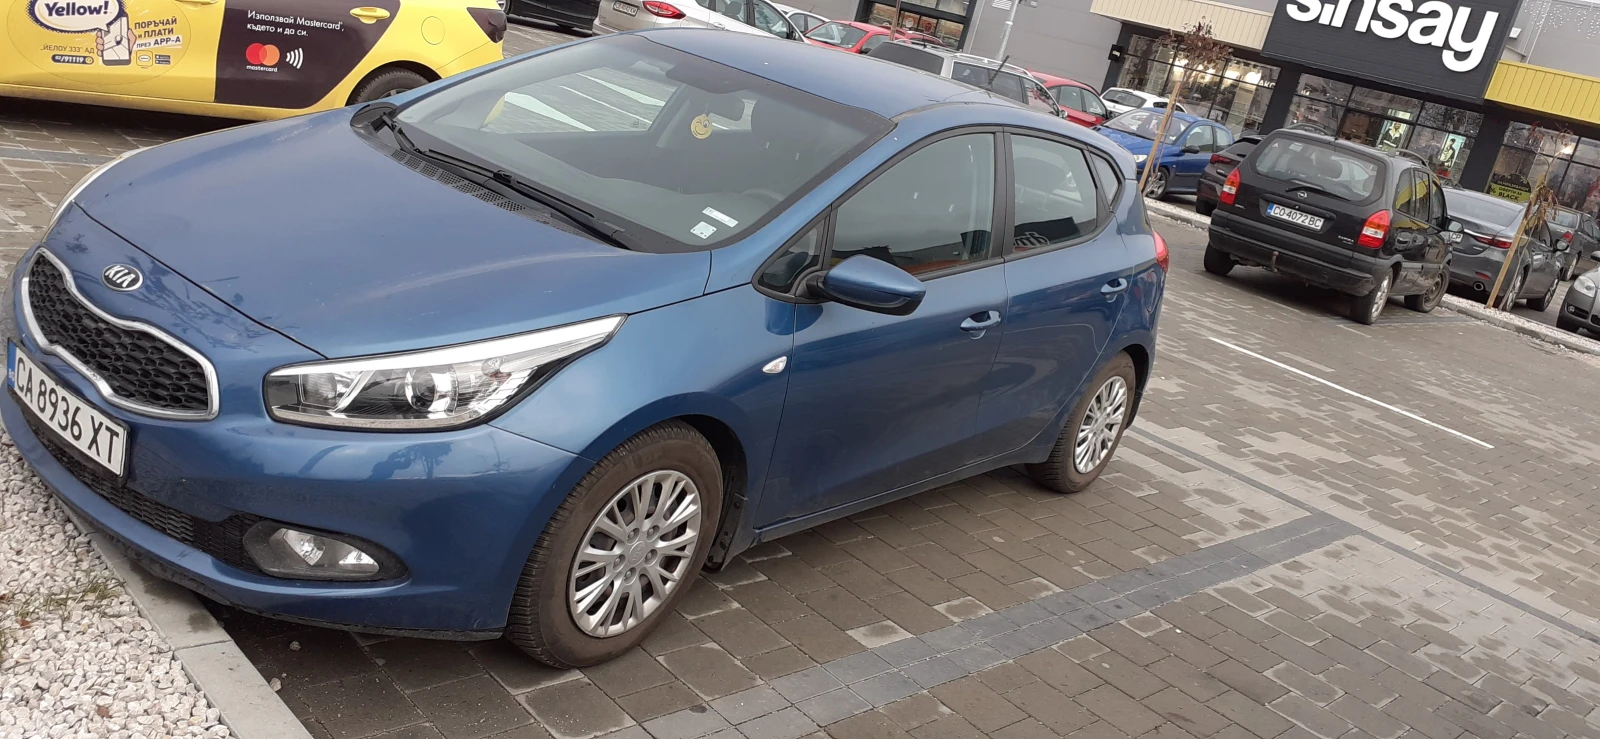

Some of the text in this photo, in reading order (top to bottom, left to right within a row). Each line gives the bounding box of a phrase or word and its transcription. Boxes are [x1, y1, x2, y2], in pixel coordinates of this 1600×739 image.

[44, 1, 109, 17] Yellow!
[247, 9, 295, 24] Използвай
[134, 16, 177, 29] ПОРЪЧАЙ
[247, 23, 275, 32] където
[143, 27, 174, 39] ПЛАТИ
[1498, 191, 1520, 202] BLACK
[1286, 211, 1308, 224] 4072
[1308, 217, 1322, 228] BC
[104, 264, 136, 288] KIA
[16, 356, 120, 465] CA 8936 XT
